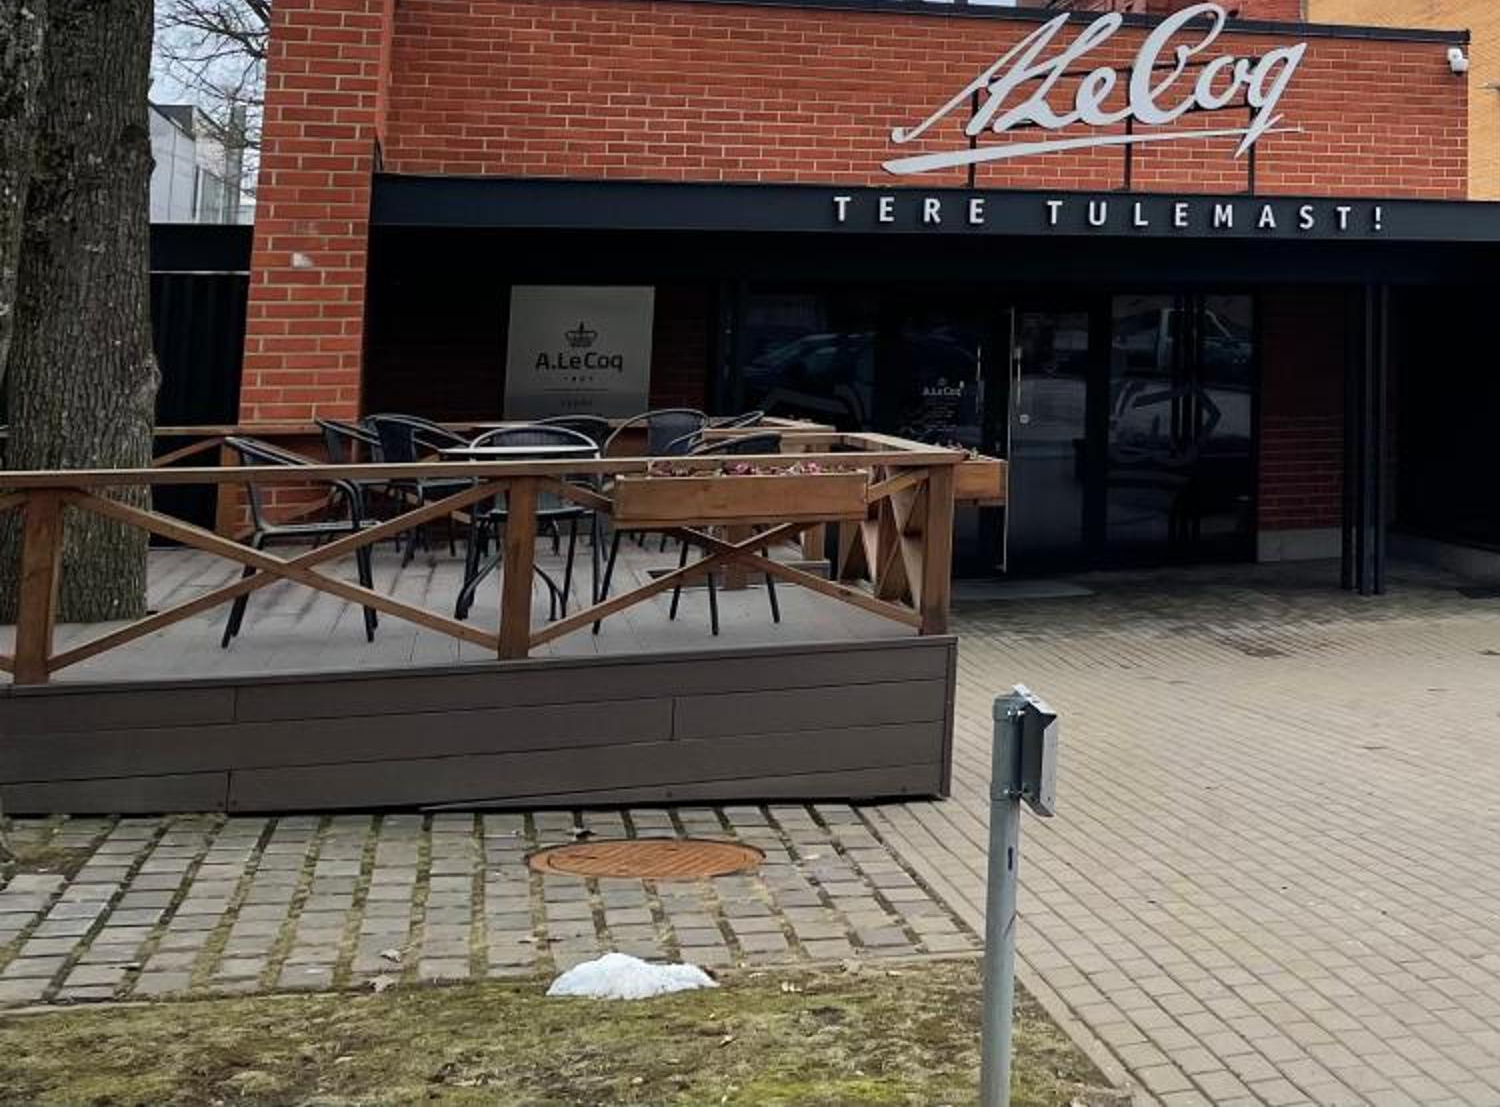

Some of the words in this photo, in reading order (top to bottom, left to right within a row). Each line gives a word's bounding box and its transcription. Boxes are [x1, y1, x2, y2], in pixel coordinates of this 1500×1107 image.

[833, 196, 985, 224] TERE
[1047, 199, 1383, 230] TULEMAST!
[535, 352, 623, 373] A.LeCoq
